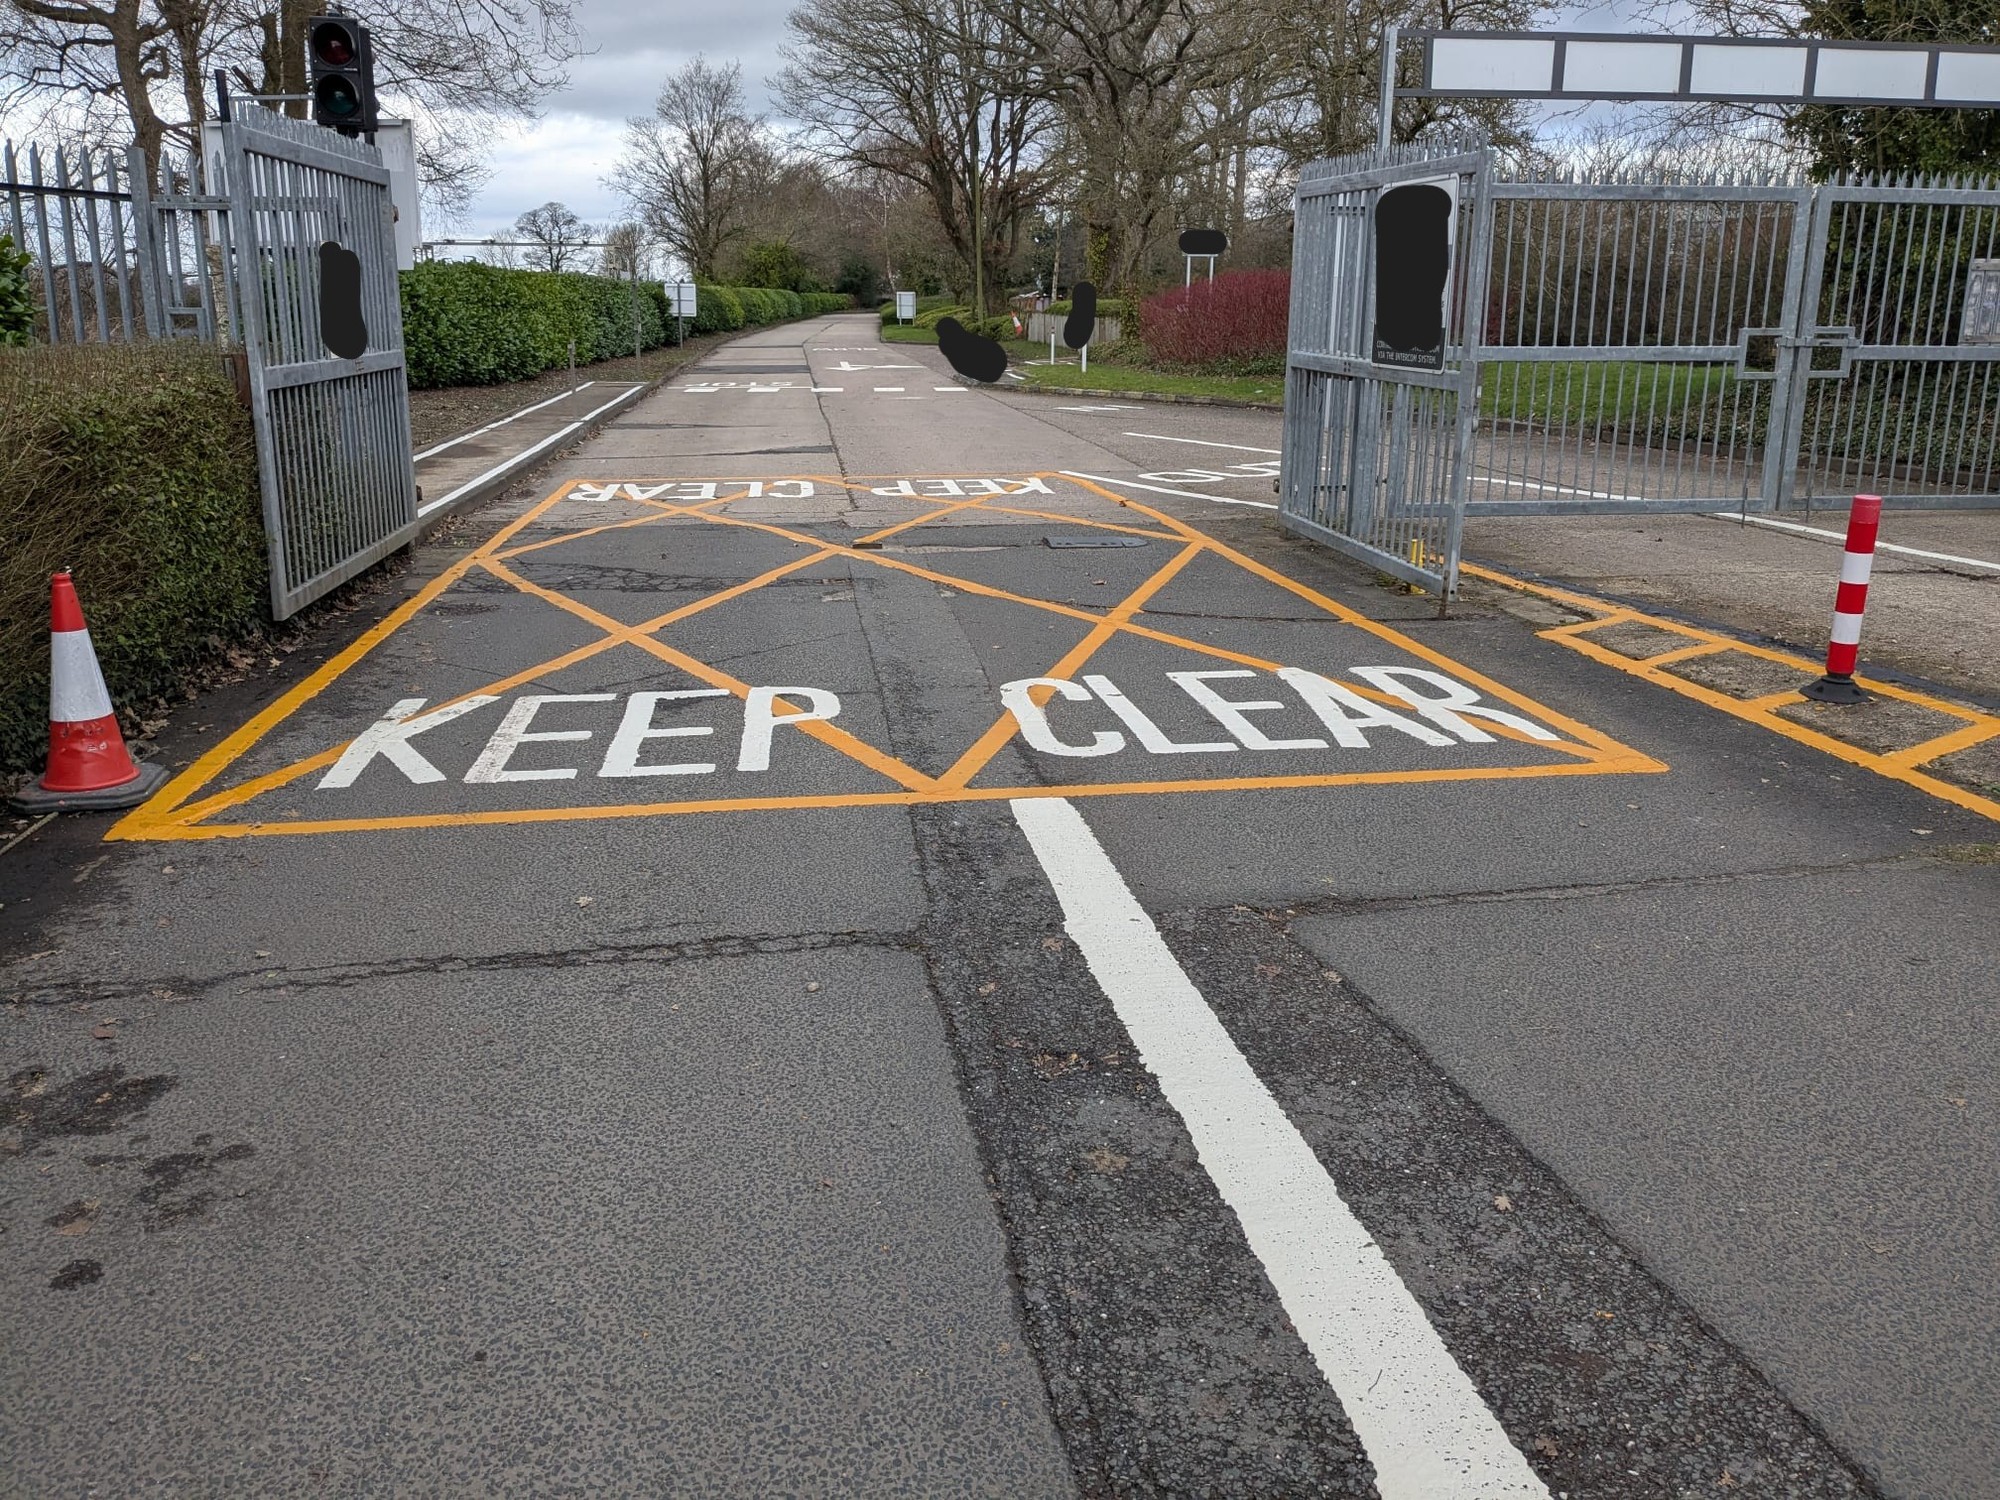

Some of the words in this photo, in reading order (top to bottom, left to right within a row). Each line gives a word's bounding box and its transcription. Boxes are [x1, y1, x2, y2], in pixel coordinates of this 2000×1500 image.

[1386, 351, 1395, 360] THE
[1395, 352, 1418, 362] INTERCOM
[568, 480, 814, 501] CLEAR
[871, 477, 1056, 496] KEEP
[314, 686, 842, 790] KEEP
[999, 667, 1561, 757] CLEAR
